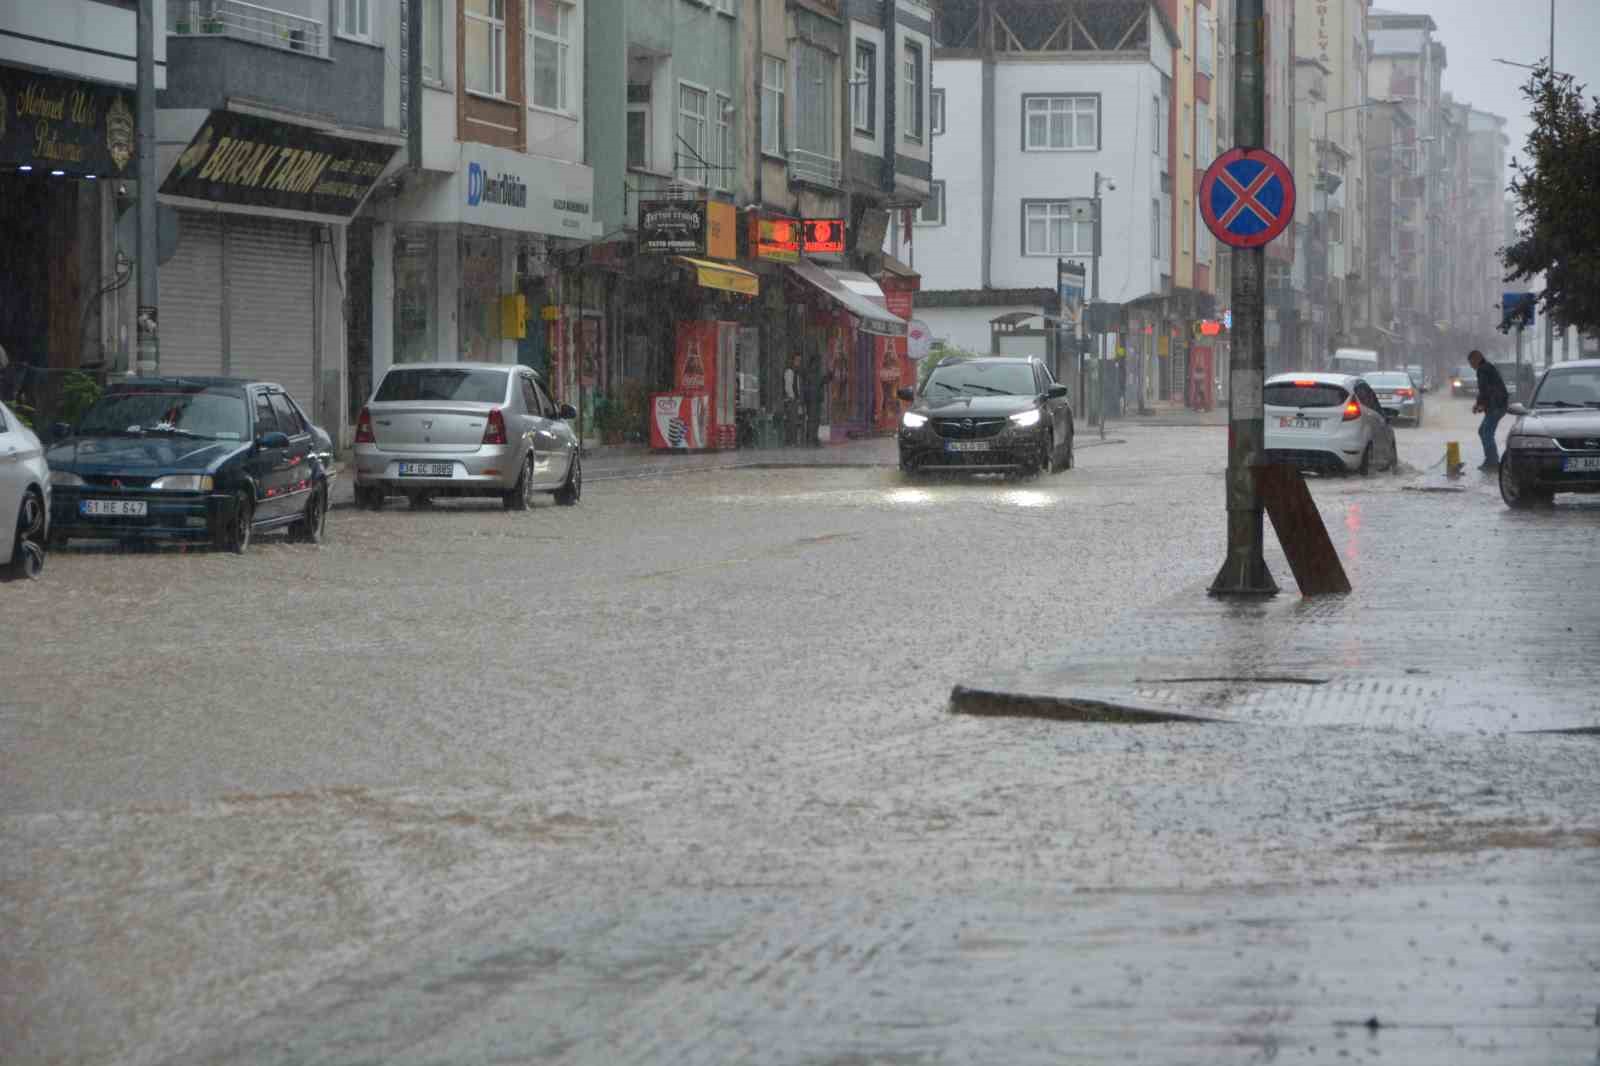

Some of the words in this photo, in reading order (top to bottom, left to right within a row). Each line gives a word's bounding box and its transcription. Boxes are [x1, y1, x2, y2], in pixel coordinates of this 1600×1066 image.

[199, 136, 277, 187] BURAK
[261, 147, 333, 193] TARIM
[482, 168, 527, 209] DemirDöküm
[103, 502, 117, 513] HE
[122, 502, 144, 514] 647
